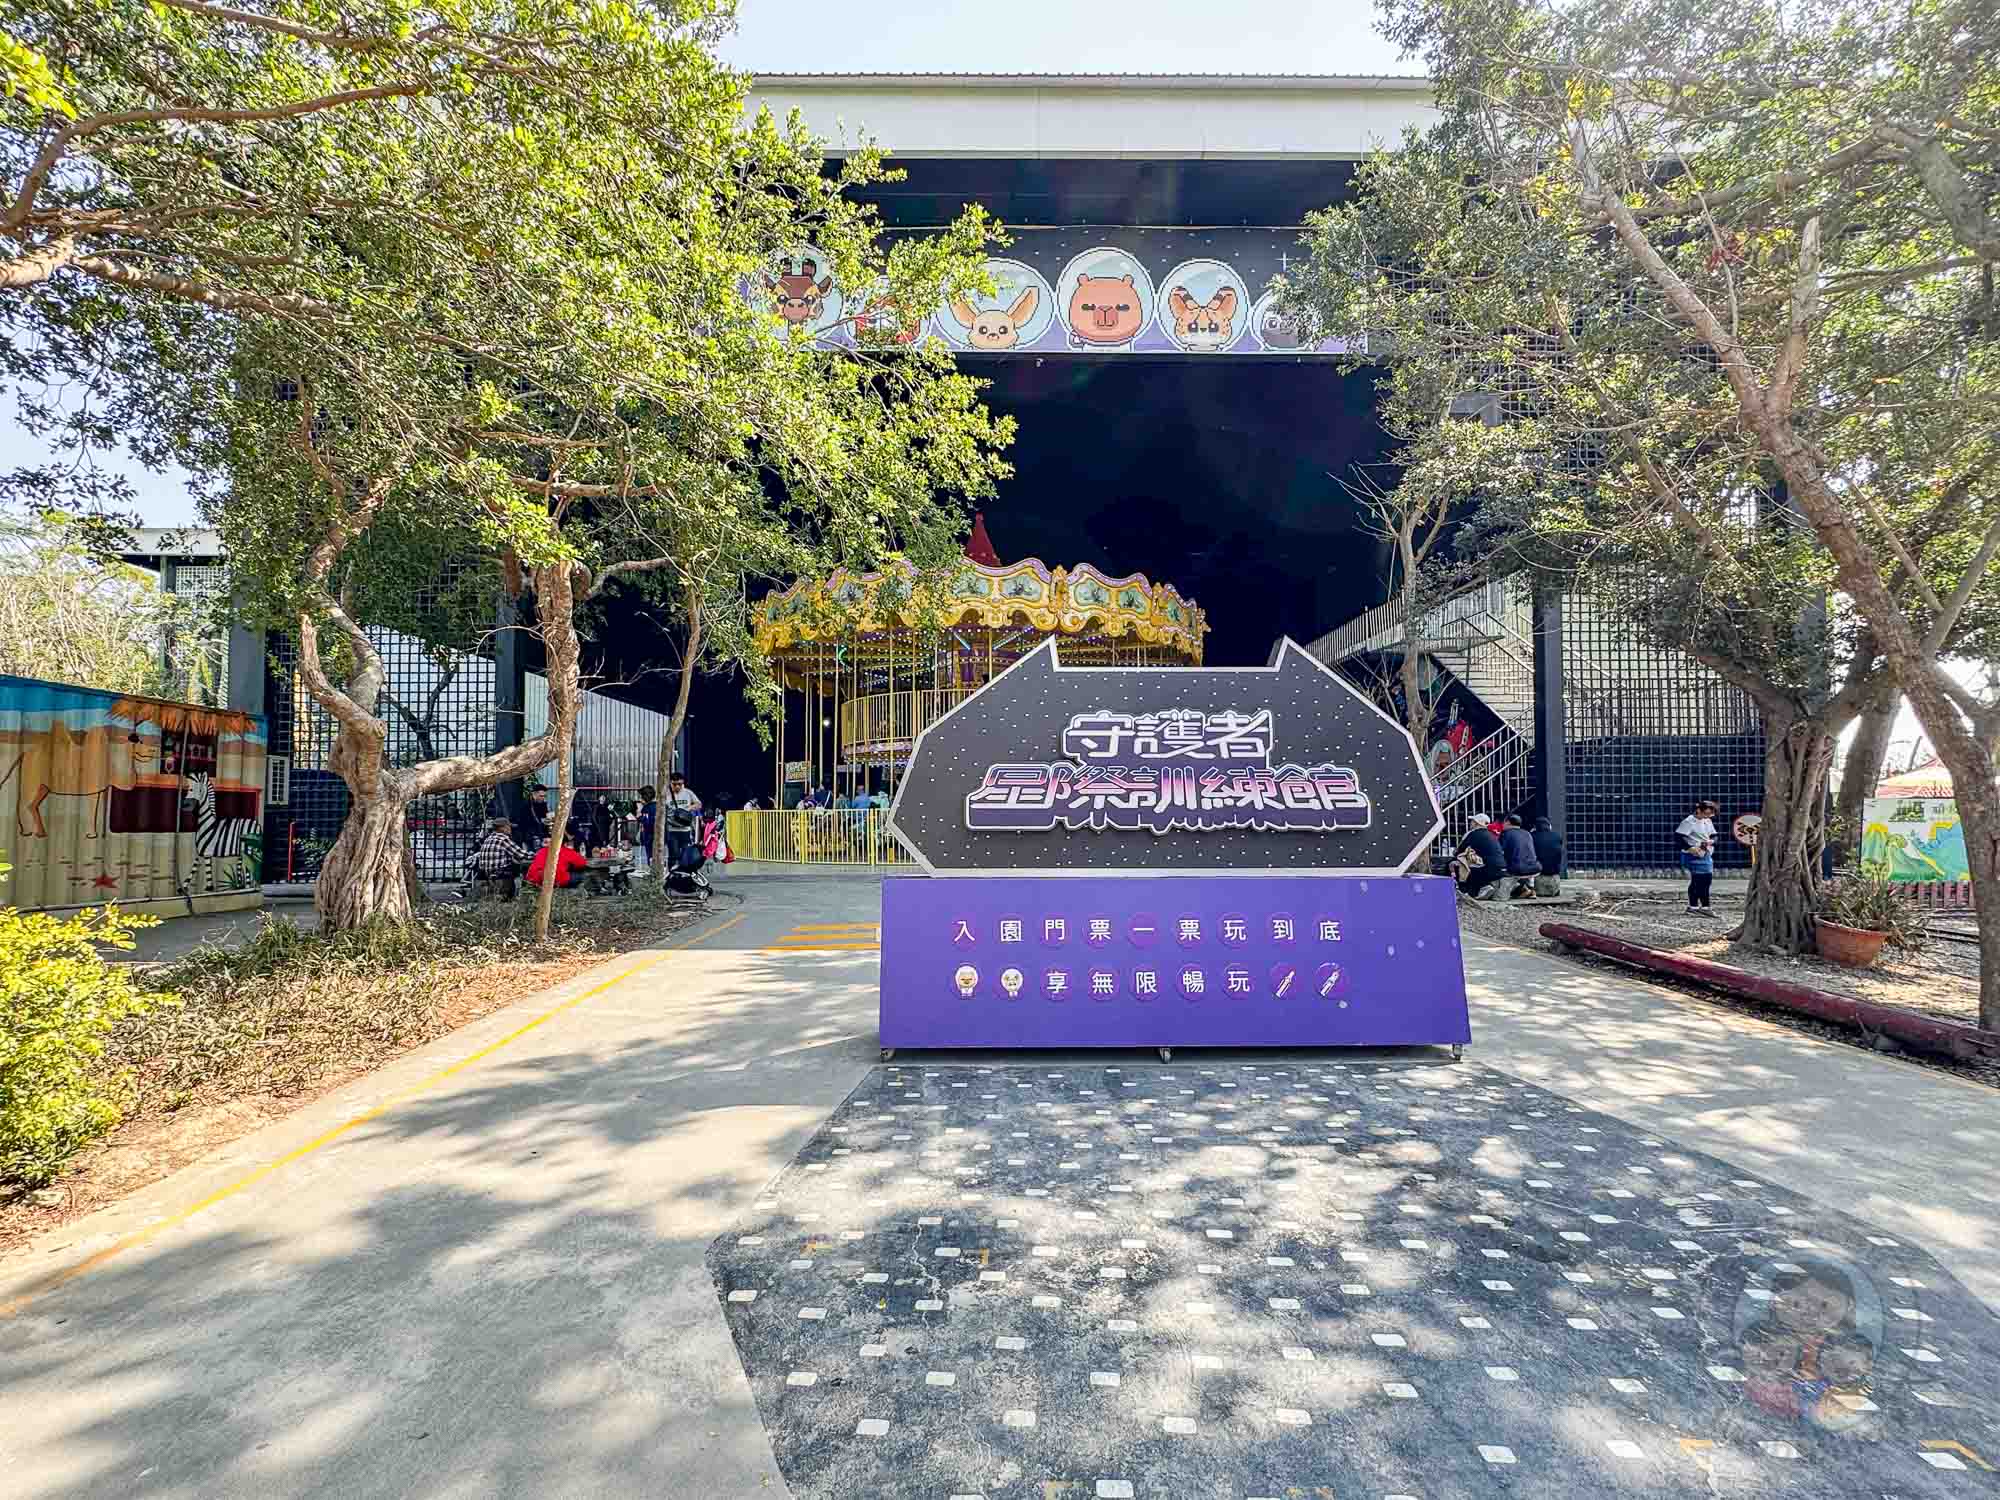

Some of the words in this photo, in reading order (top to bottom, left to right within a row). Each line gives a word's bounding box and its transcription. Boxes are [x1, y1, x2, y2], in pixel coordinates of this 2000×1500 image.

[1066, 711, 1272, 758] 守護者
[970, 764, 1368, 813] 星際訓練館
[954, 919, 1341, 941] 入園門票一票玩到底
[1046, 970, 1250, 994] 享無限暢玩
